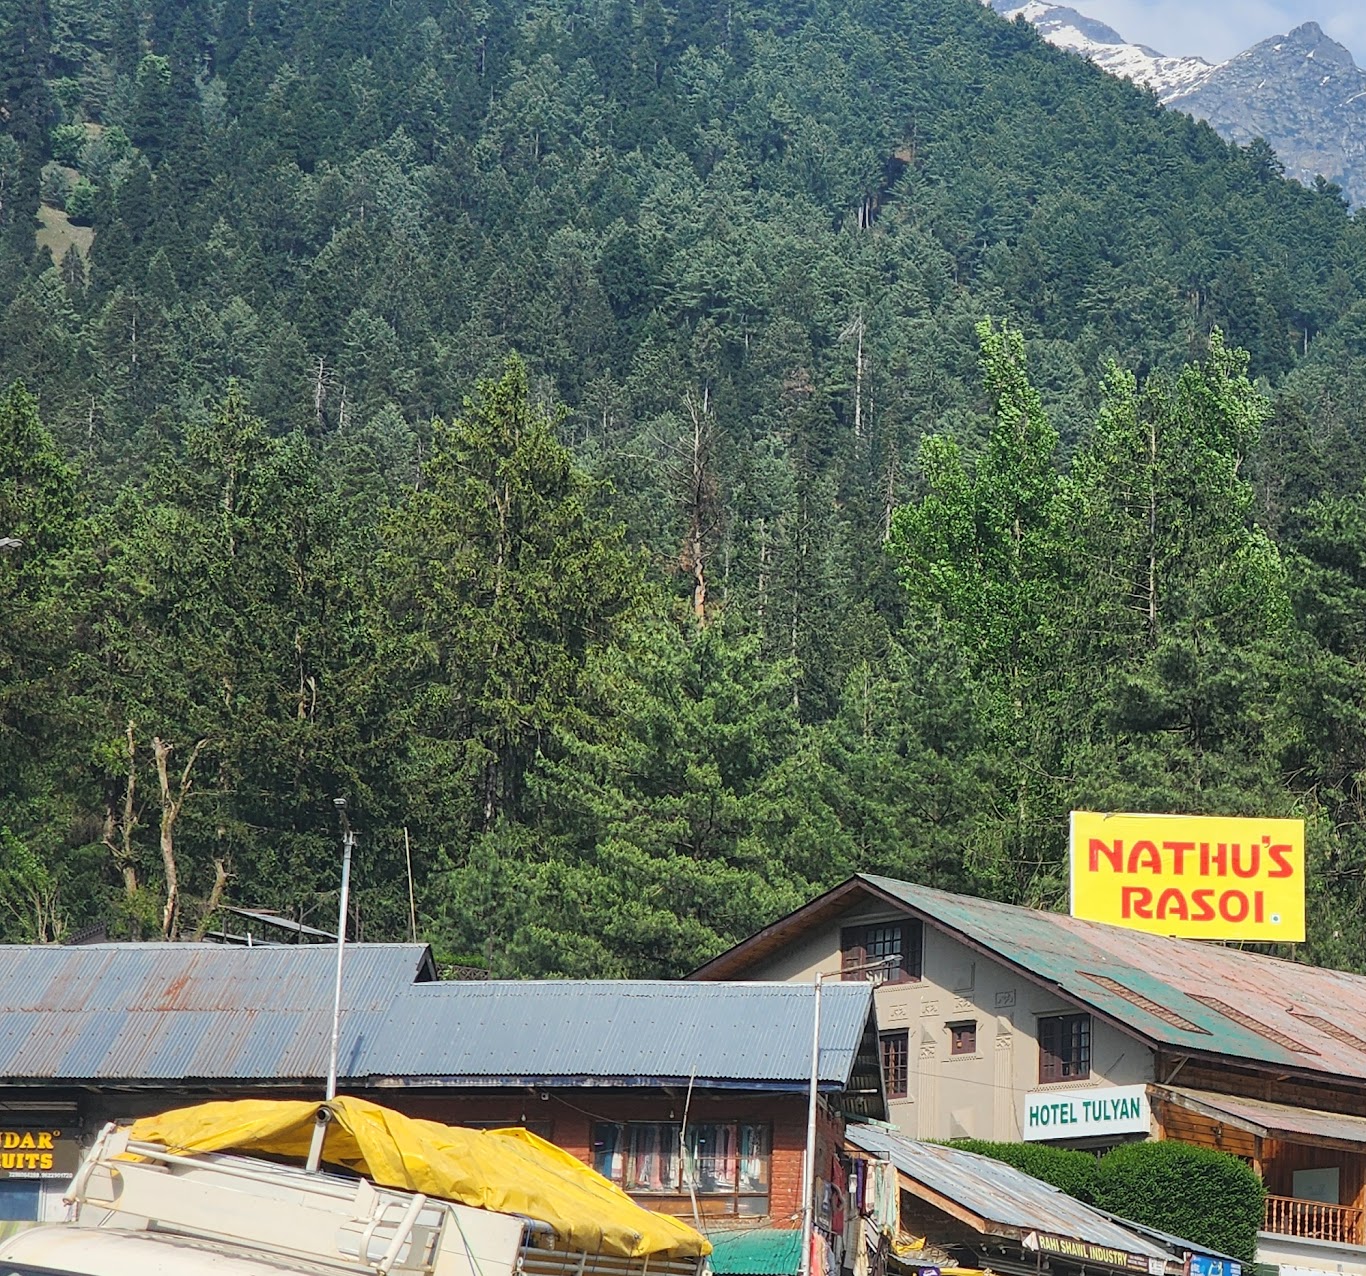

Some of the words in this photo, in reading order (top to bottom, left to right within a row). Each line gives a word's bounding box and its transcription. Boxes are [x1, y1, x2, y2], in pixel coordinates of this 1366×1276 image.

[1088, 835, 1294, 879] NATHU'S
[1121, 886, 1265, 924] RASOI
[1029, 1102, 1078, 1127] HOTEL
[1082, 1097, 1140, 1122] TULYAN
[0, 1131, 54, 1149] DAR
[0, 1153, 53, 1169] UITS
[1038, 1235, 1060, 1254] RAHI
[1060, 1240, 1089, 1259] SHAWL
[1089, 1246, 1128, 1266] INDUSTRY
